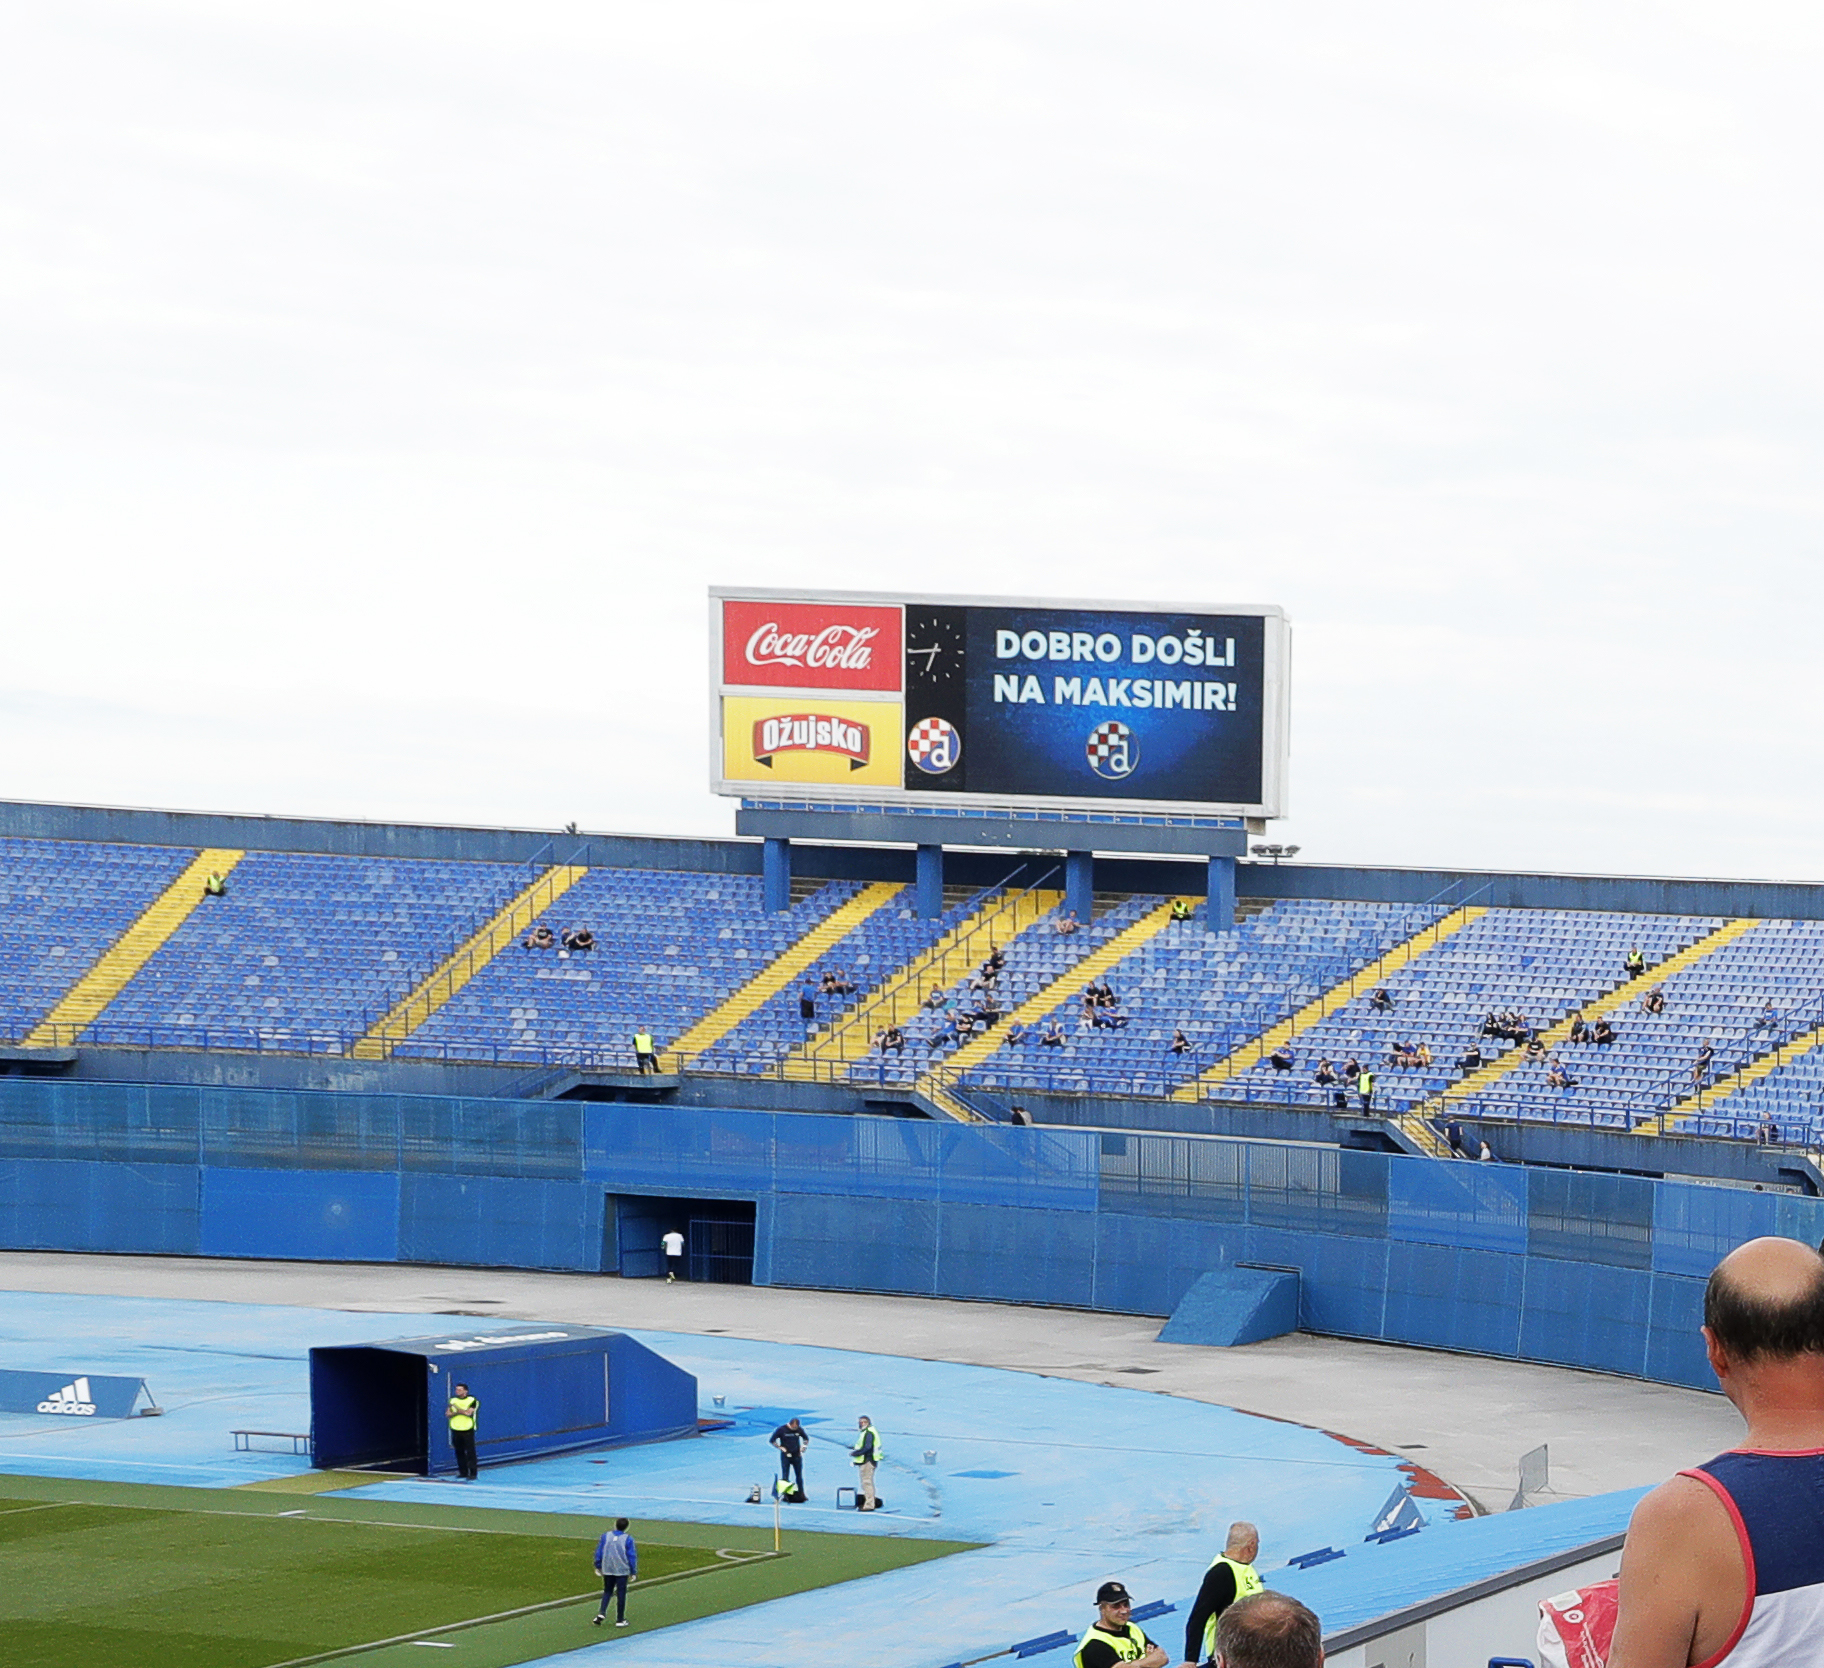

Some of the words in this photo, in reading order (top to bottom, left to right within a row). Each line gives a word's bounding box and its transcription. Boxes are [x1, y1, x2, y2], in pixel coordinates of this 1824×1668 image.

[745, 622, 880, 669] Coca-Cola
[996, 629, 1122, 663] DOBRO
[1131, 628, 1235, 667] DOŠLI
[993, 674, 1045, 704] NA
[1054, 676, 1237, 711] MAKSIMIR!
[763, 715, 862, 753] Ožujsko
[37, 1401, 97, 1416] adidas
